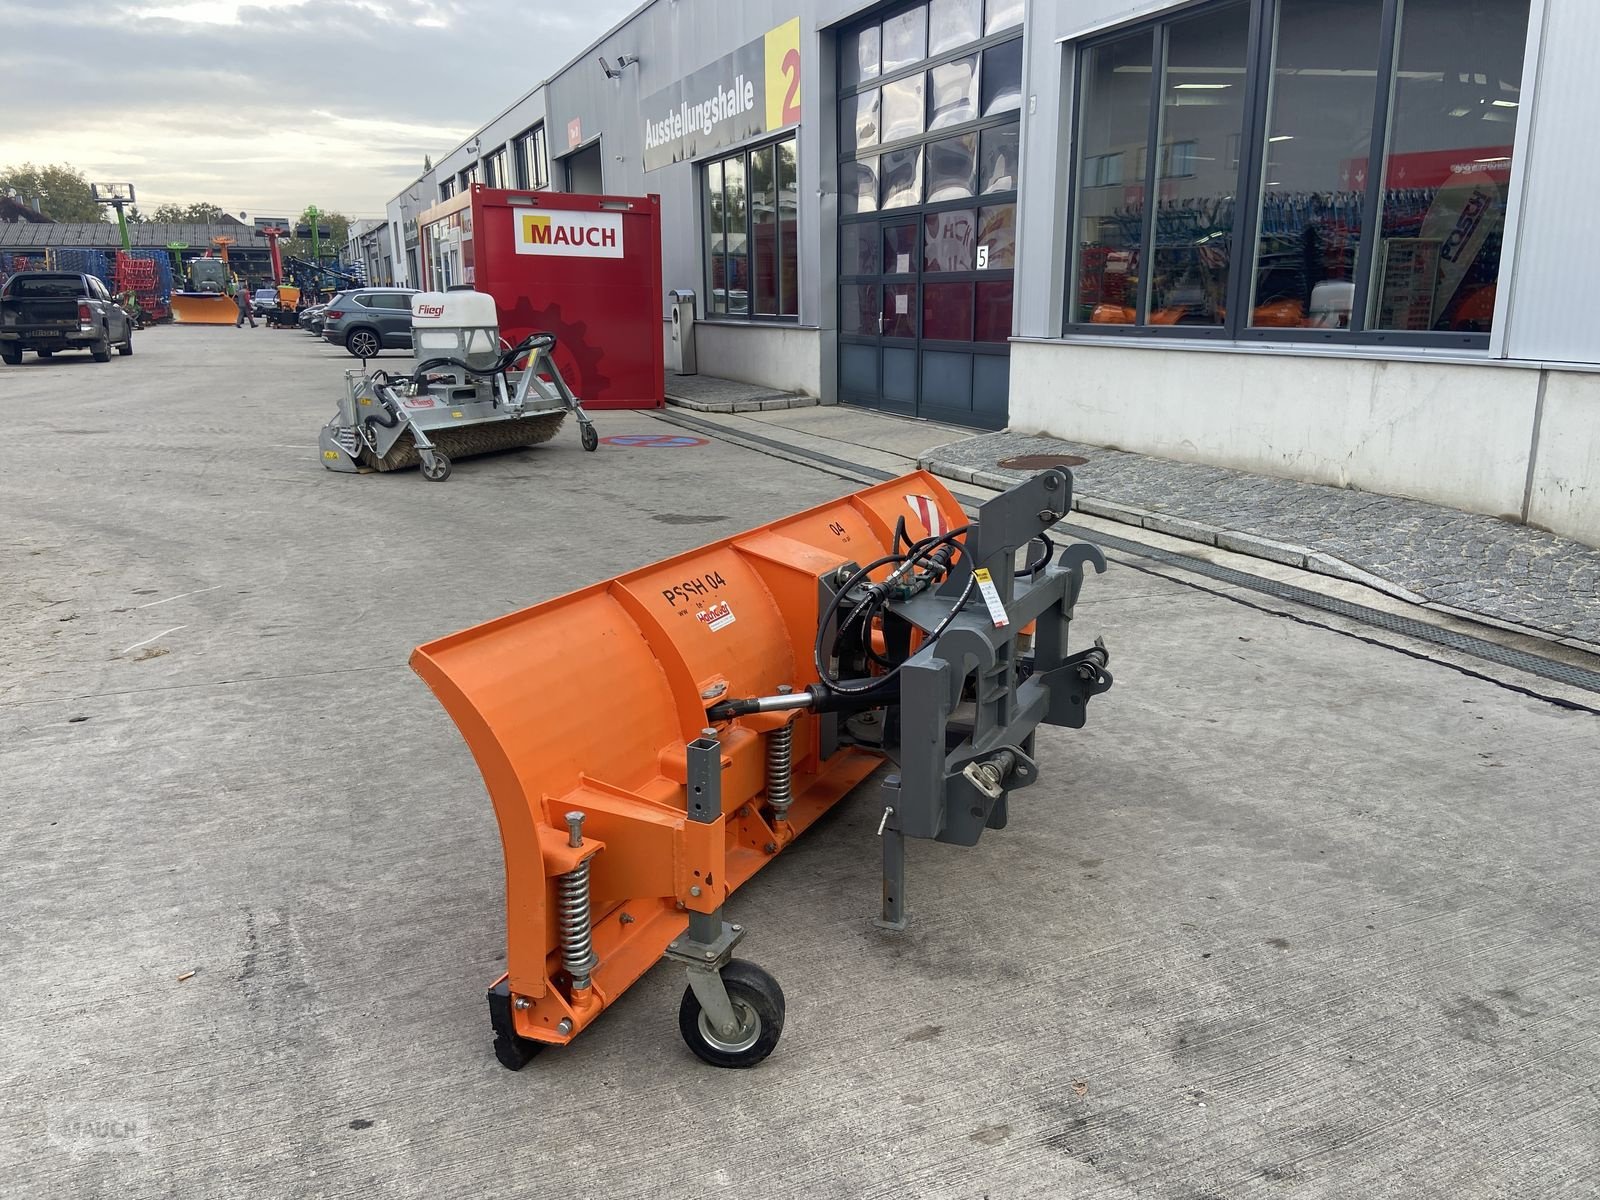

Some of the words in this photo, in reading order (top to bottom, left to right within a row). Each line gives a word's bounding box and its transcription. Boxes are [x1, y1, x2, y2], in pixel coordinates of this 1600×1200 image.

[645, 74, 754, 150] Ausstellungshalle
[782, 48, 800, 128] 2
[531, 223, 616, 247] MAUCH
[978, 248, 986, 267] 5
[418, 304, 445, 317] Fliegl
[829, 521, 846, 536] 04
[662, 578, 709, 607] PSSH
[705, 570, 727, 590] 04
